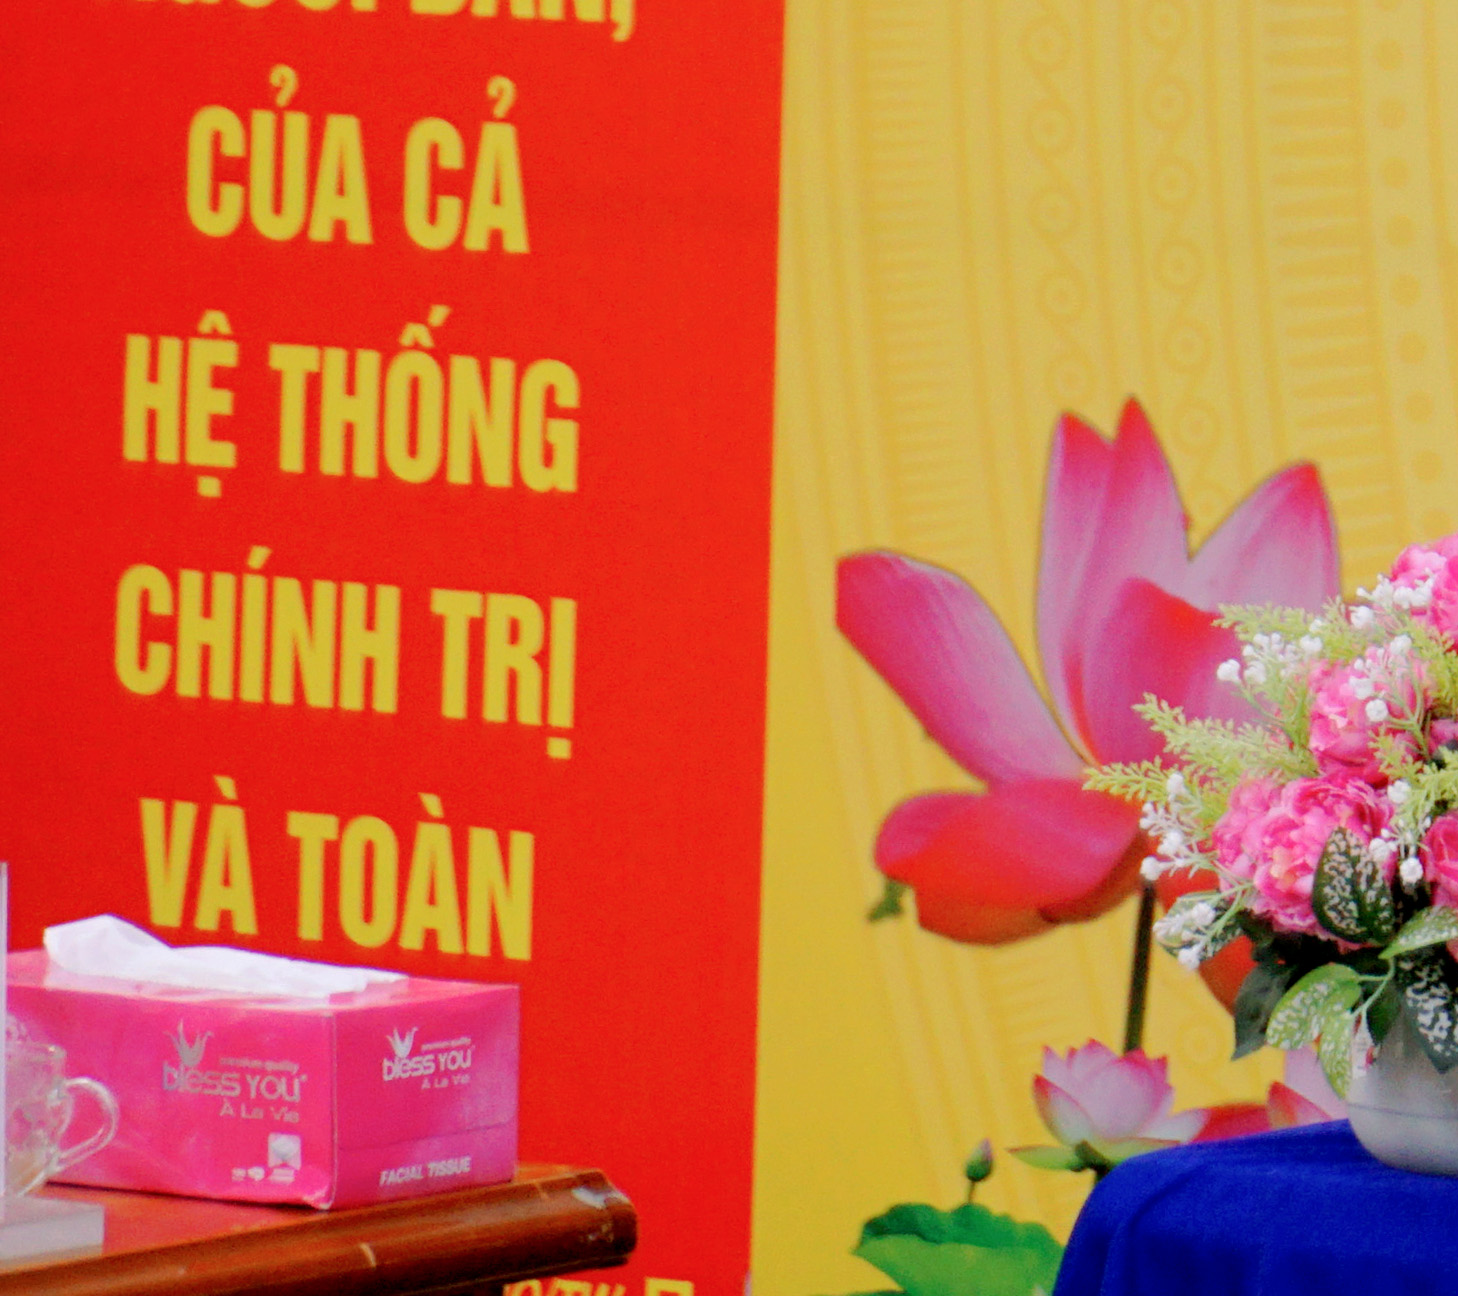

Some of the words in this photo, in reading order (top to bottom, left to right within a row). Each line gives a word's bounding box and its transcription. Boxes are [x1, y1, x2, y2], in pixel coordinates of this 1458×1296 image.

[187, 65, 372, 244] CỦA
[404, 76, 529, 253] CẢ
[124, 311, 238, 497] HỆ
[269, 305, 579, 492] THỐNG
[115, 546, 400, 713] CHÍNH
[431, 589, 576, 759] TRỊ
[141, 776, 257, 934] VÀ
[287, 794, 534, 960] TOÀN
[246, 1075, 300, 1103] YOU
[437, 1049, 472, 1072] YOU
[428, 1156, 471, 1177] TISSUE
